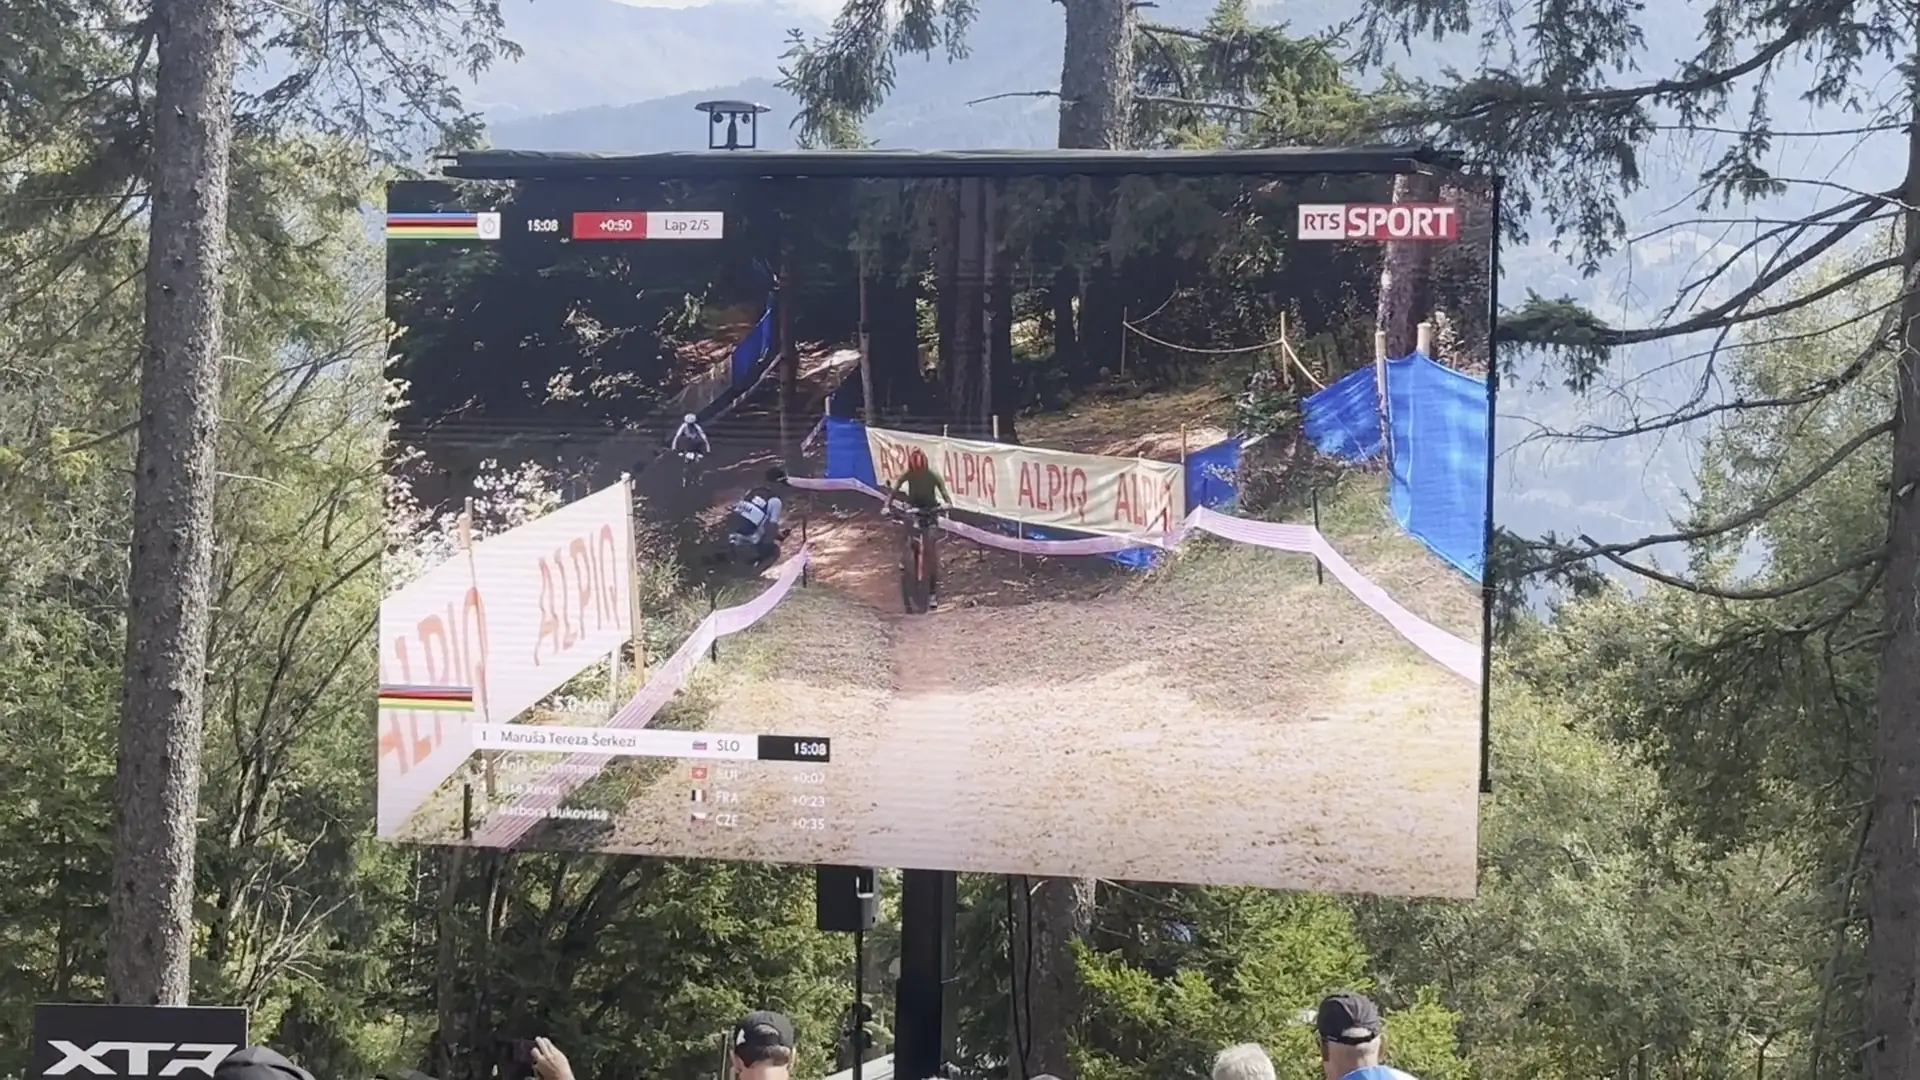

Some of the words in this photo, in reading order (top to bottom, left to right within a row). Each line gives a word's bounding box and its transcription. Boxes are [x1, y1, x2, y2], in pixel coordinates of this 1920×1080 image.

[527, 219, 559, 232] 15:08
[600, 219, 633, 232] +0:50
[664, 218, 688, 232] Lap
[690, 219, 710, 231] 2/5
[1304, 213, 1341, 231] RTS
[1348, 207, 1454, 237] SPORT
[942, 449, 996, 507] ALPIQ
[1018, 461, 1088, 524] ALPIQ
[533, 523, 621, 667] ALPIQ
[482, 731, 487, 741] 1
[501, 731, 546, 745] Maruša
[549, 733, 588, 746] Tereza
[592, 732, 636, 749] Šerkezi
[716, 739, 740, 752] SLO
[793, 742, 828, 756] 15:08
[716, 791, 738, 804] FRA
[716, 814, 738, 827] CZE
[793, 818, 825, 830] +0:35
[42, 1040, 238, 1077] XTR
